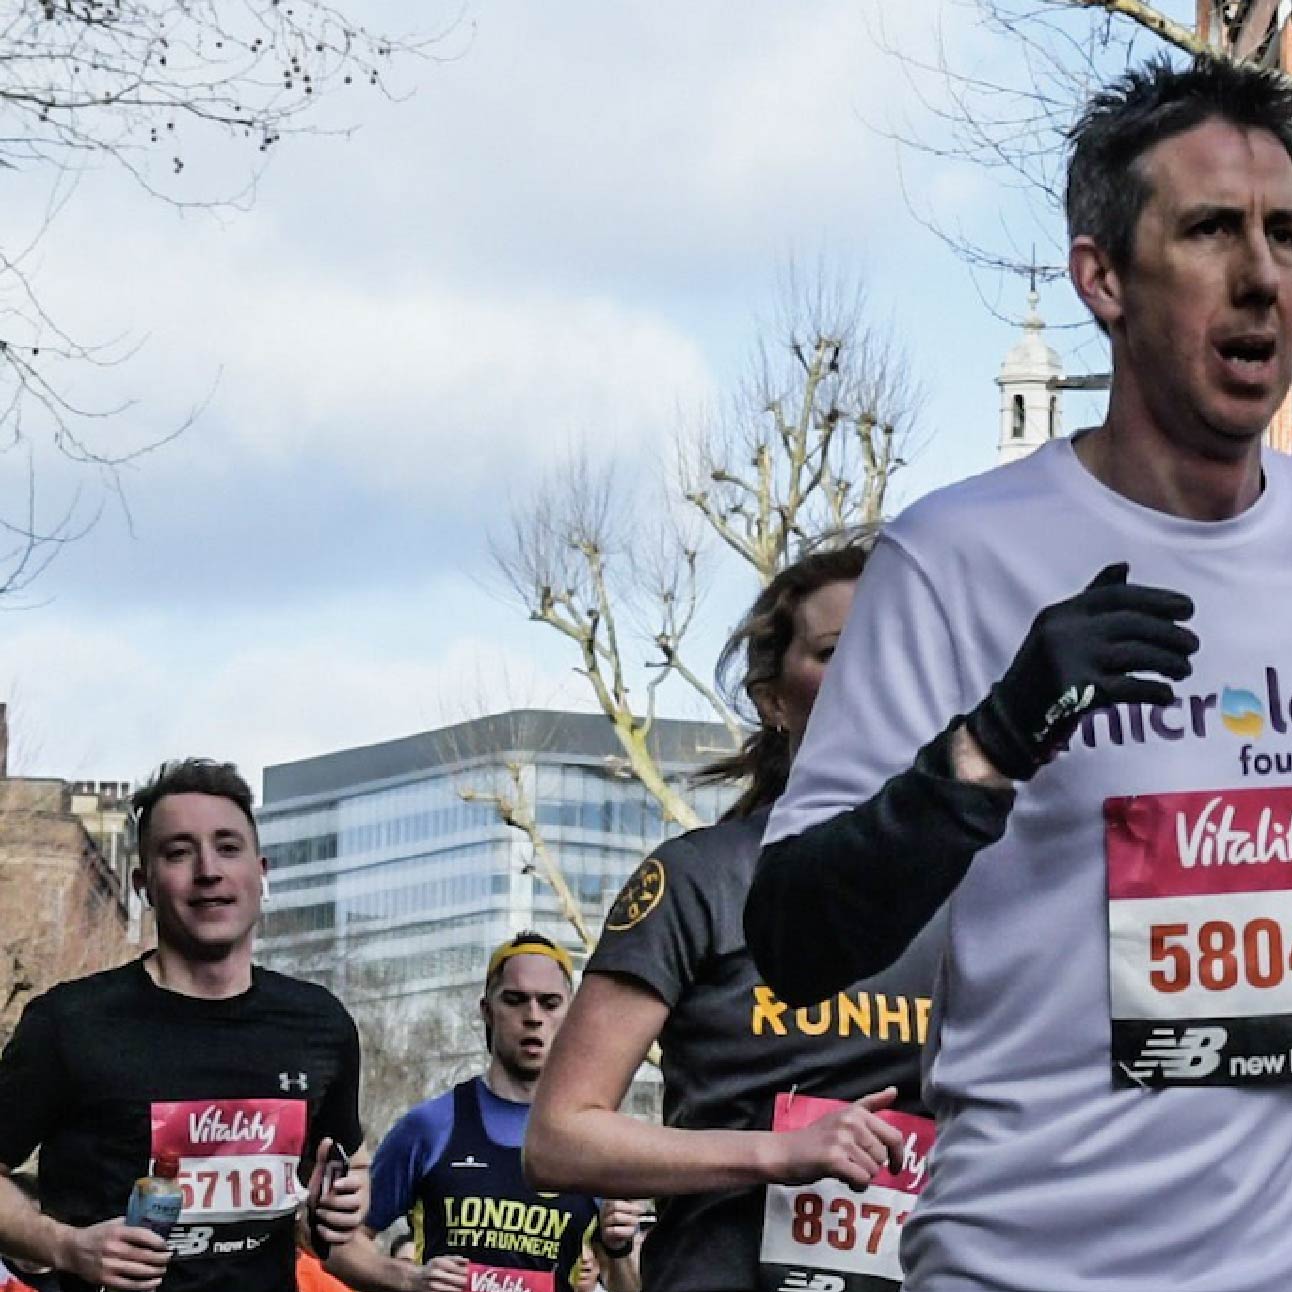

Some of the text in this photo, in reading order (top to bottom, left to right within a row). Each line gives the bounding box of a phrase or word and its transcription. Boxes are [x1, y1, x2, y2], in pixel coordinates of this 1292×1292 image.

[1229, 1053, 1286, 1077] new
[189, 1104, 276, 1152] Vitality
[177, 1168, 274, 1210] 5718
[443, 1196, 573, 1240] LONDON
[791, 1192, 908, 1256] 837
